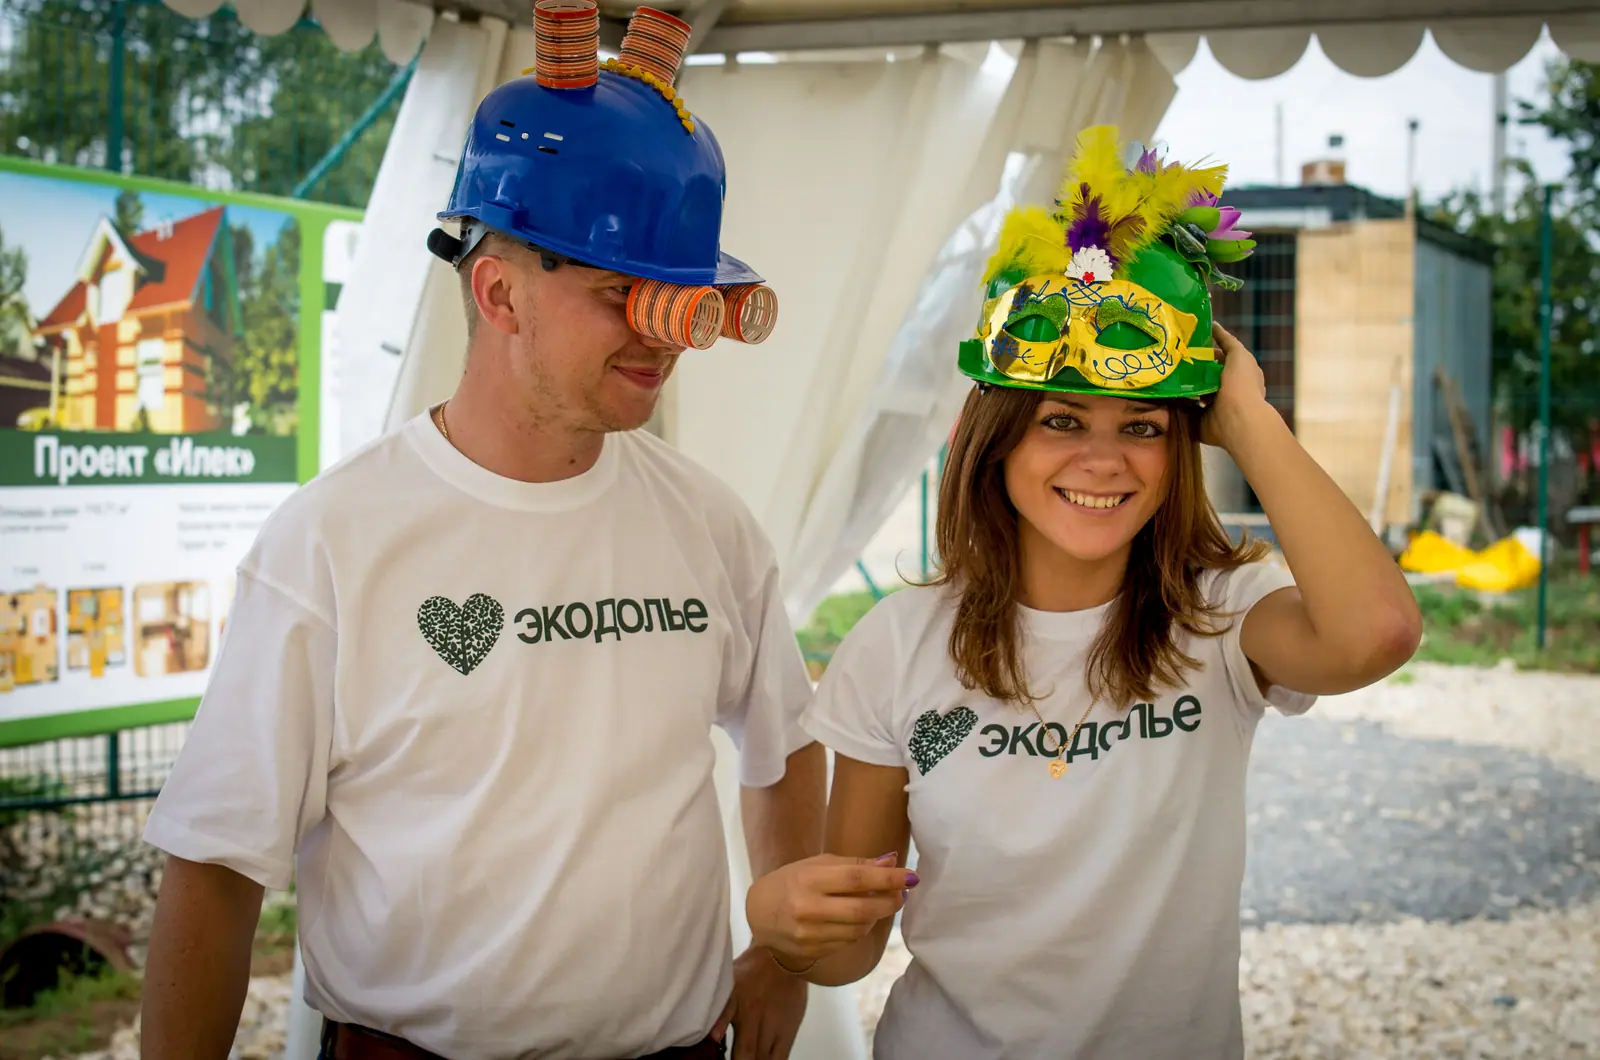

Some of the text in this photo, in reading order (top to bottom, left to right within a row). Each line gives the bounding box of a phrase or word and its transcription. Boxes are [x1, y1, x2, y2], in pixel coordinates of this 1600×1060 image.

[34, 435, 256, 485] Проект «Илек»
[513, 597, 709, 644] экодолье
